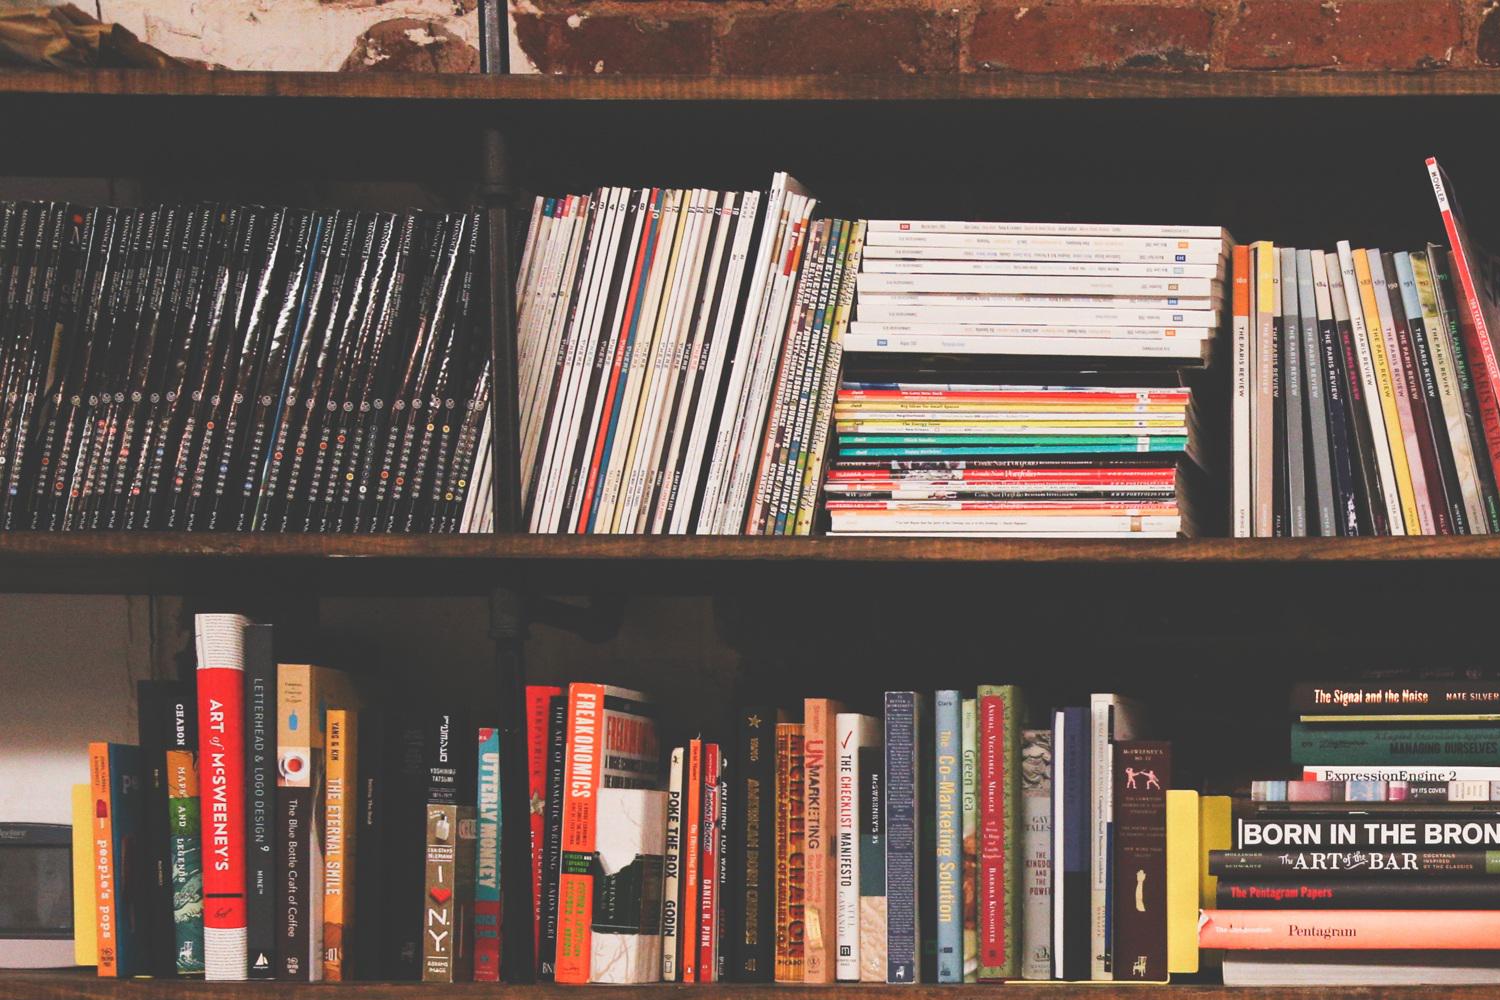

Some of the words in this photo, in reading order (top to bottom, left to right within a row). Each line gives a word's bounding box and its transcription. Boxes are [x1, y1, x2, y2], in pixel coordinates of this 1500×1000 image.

[1431, 171, 1446, 203] HOWLER
[469, 214, 481, 254] MONOCLE
[818, 257, 834, 310] BELIEVER
[1314, 689, 1331, 703] The
[1333, 689, 1363, 706] Signal
[1365, 690, 1382, 703] and
[1384, 689, 1400, 703] the
[1402, 690, 1429, 703] Noise
[1446, 692, 1467, 701] NATE
[1469, 692, 1500, 701] SILVER
[176, 704, 185, 745] CHABON
[210, 699, 224, 733] ART
[254, 678, 264, 751] LETTERHEAD
[209, 737, 224, 750] of
[571, 693, 596, 798] FREAKONOMICS
[254, 753, 264, 762] &
[841, 755, 852, 772] THE
[254, 768, 264, 796] LOGO
[1325, 770, 1445, 782] ExpressionEngine
[1448, 771, 1457, 782] 2
[212, 754, 229, 871] McSWEENEY'S
[288, 800, 298, 816] The
[669, 792, 680, 823] POKE
[841, 776, 852, 828] CHECKLIST
[254, 801, 264, 843] DESIGN
[288, 819, 298, 838] Blue
[1244, 823, 1321, 845] BORN
[1331, 824, 1356, 844] IN
[1364, 823, 1416, 845] THE
[667, 826, 679, 849] THE
[288, 842, 298, 868] Bottle
[665, 852, 678, 878] BOX
[840, 833, 852, 887] MANIFESTO
[1278, 854, 1293, 865] The
[1293, 853, 1342, 870] ART
[1368, 853, 1418, 870] BAR
[288, 871, 298, 893] Craft
[1231, 887, 1247, 897] The
[1250, 886, 1298, 900] Pentagram
[1301, 886, 1333, 899] Papers
[288, 896, 298, 907] of
[288, 908, 298, 937] Coffee
[664, 900, 676, 936] GODIN
[1288, 924, 1357, 939] Pentagram
